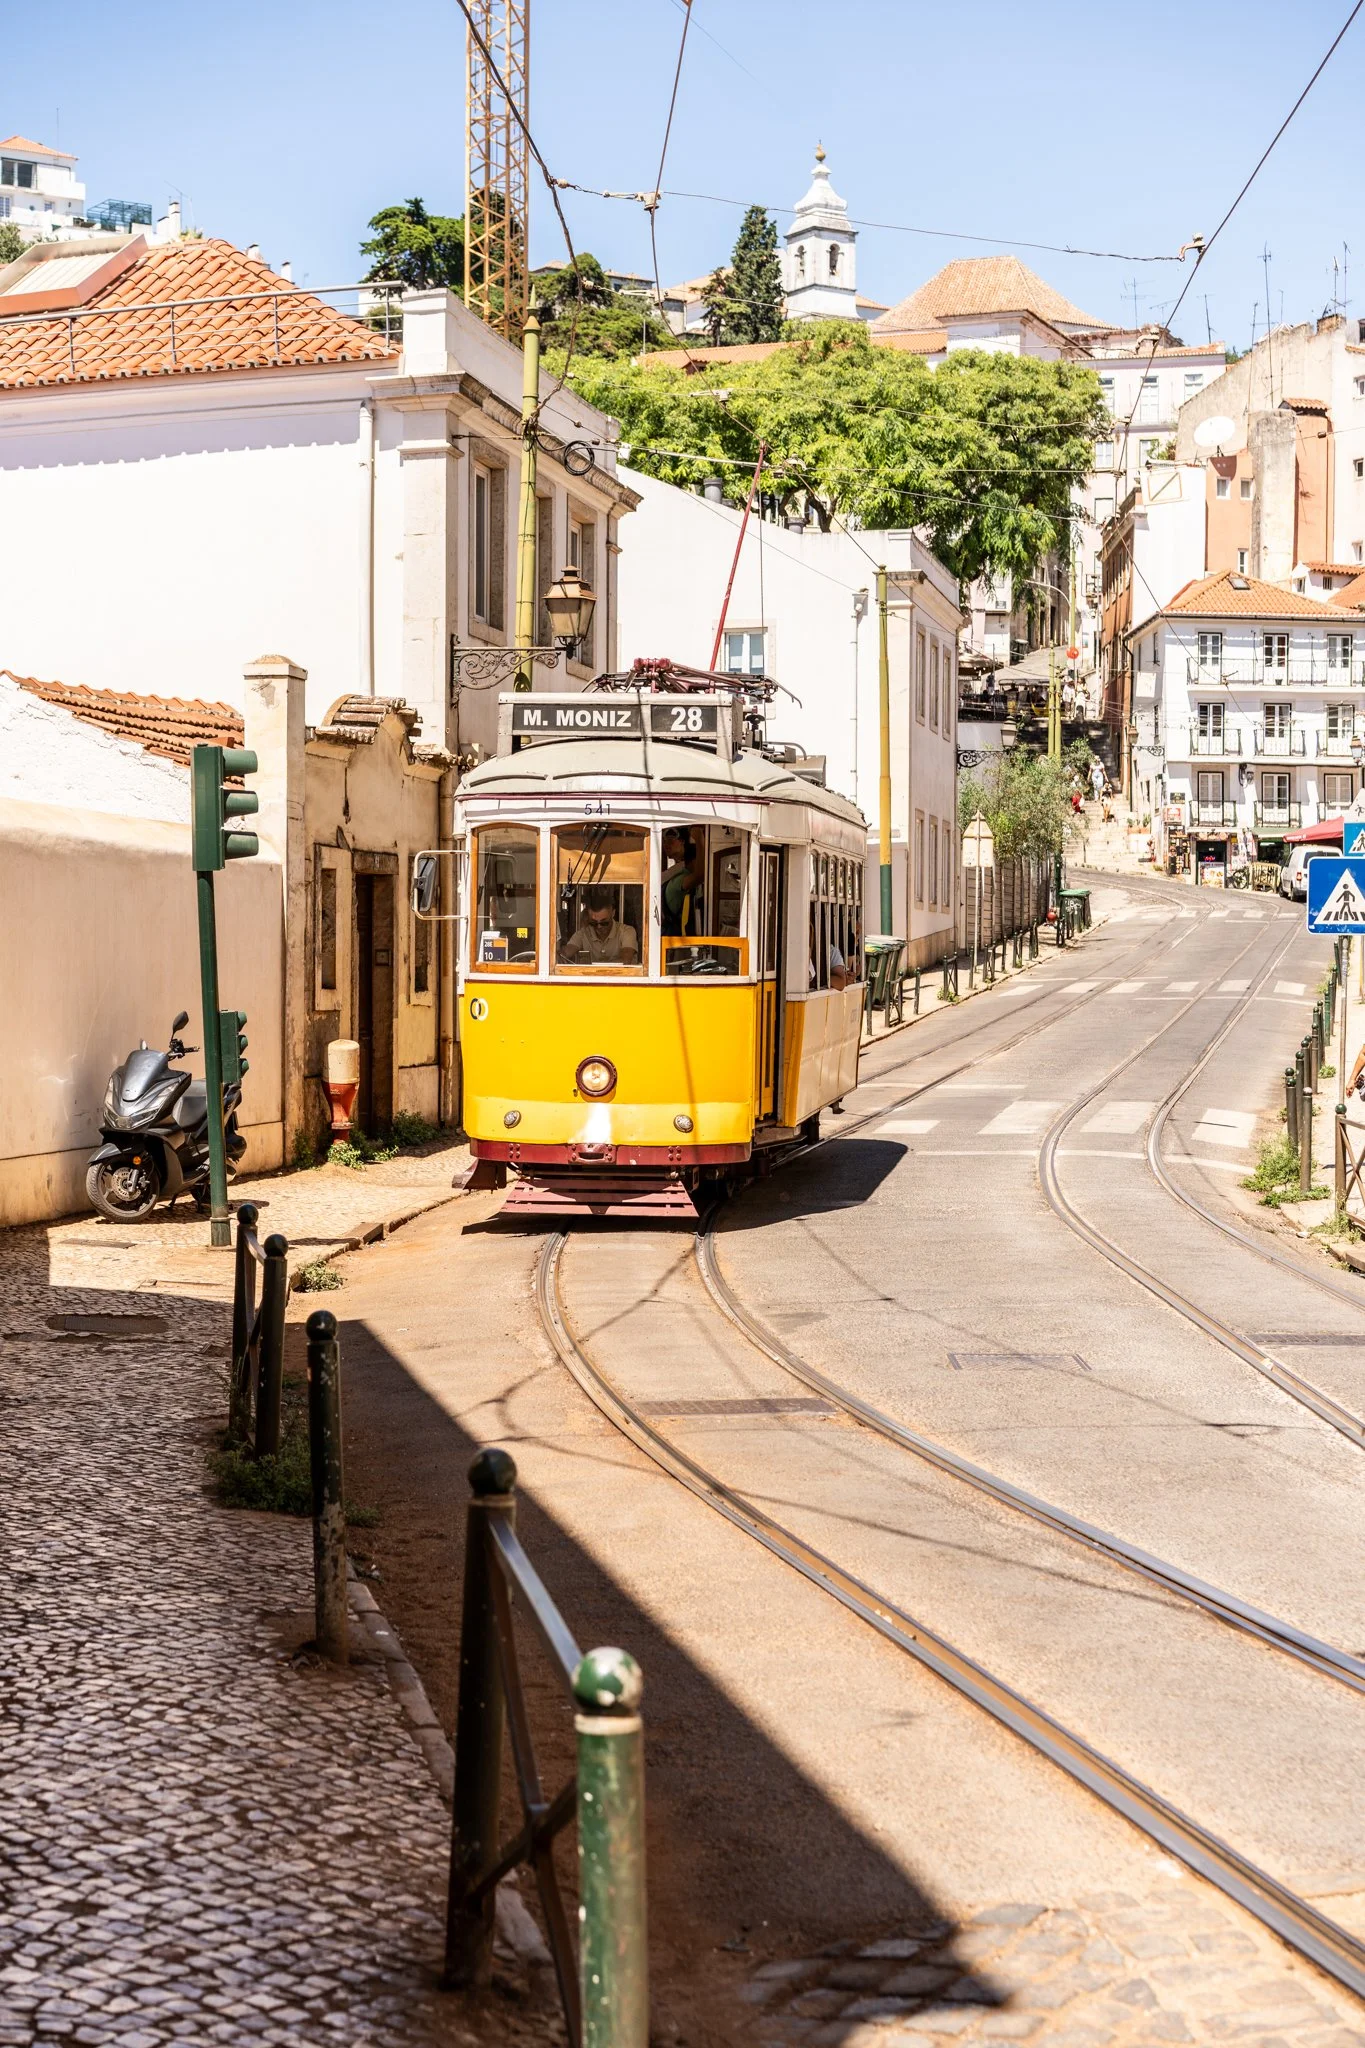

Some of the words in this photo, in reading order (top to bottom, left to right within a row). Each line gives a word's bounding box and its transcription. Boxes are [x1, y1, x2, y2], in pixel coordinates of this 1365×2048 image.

[523, 709, 548, 726] M.
[556, 709, 632, 727] MONIZ
[670, 706, 703, 732] 28
[584, 804, 612, 816] 541
[484, 952, 494, 961] 10
